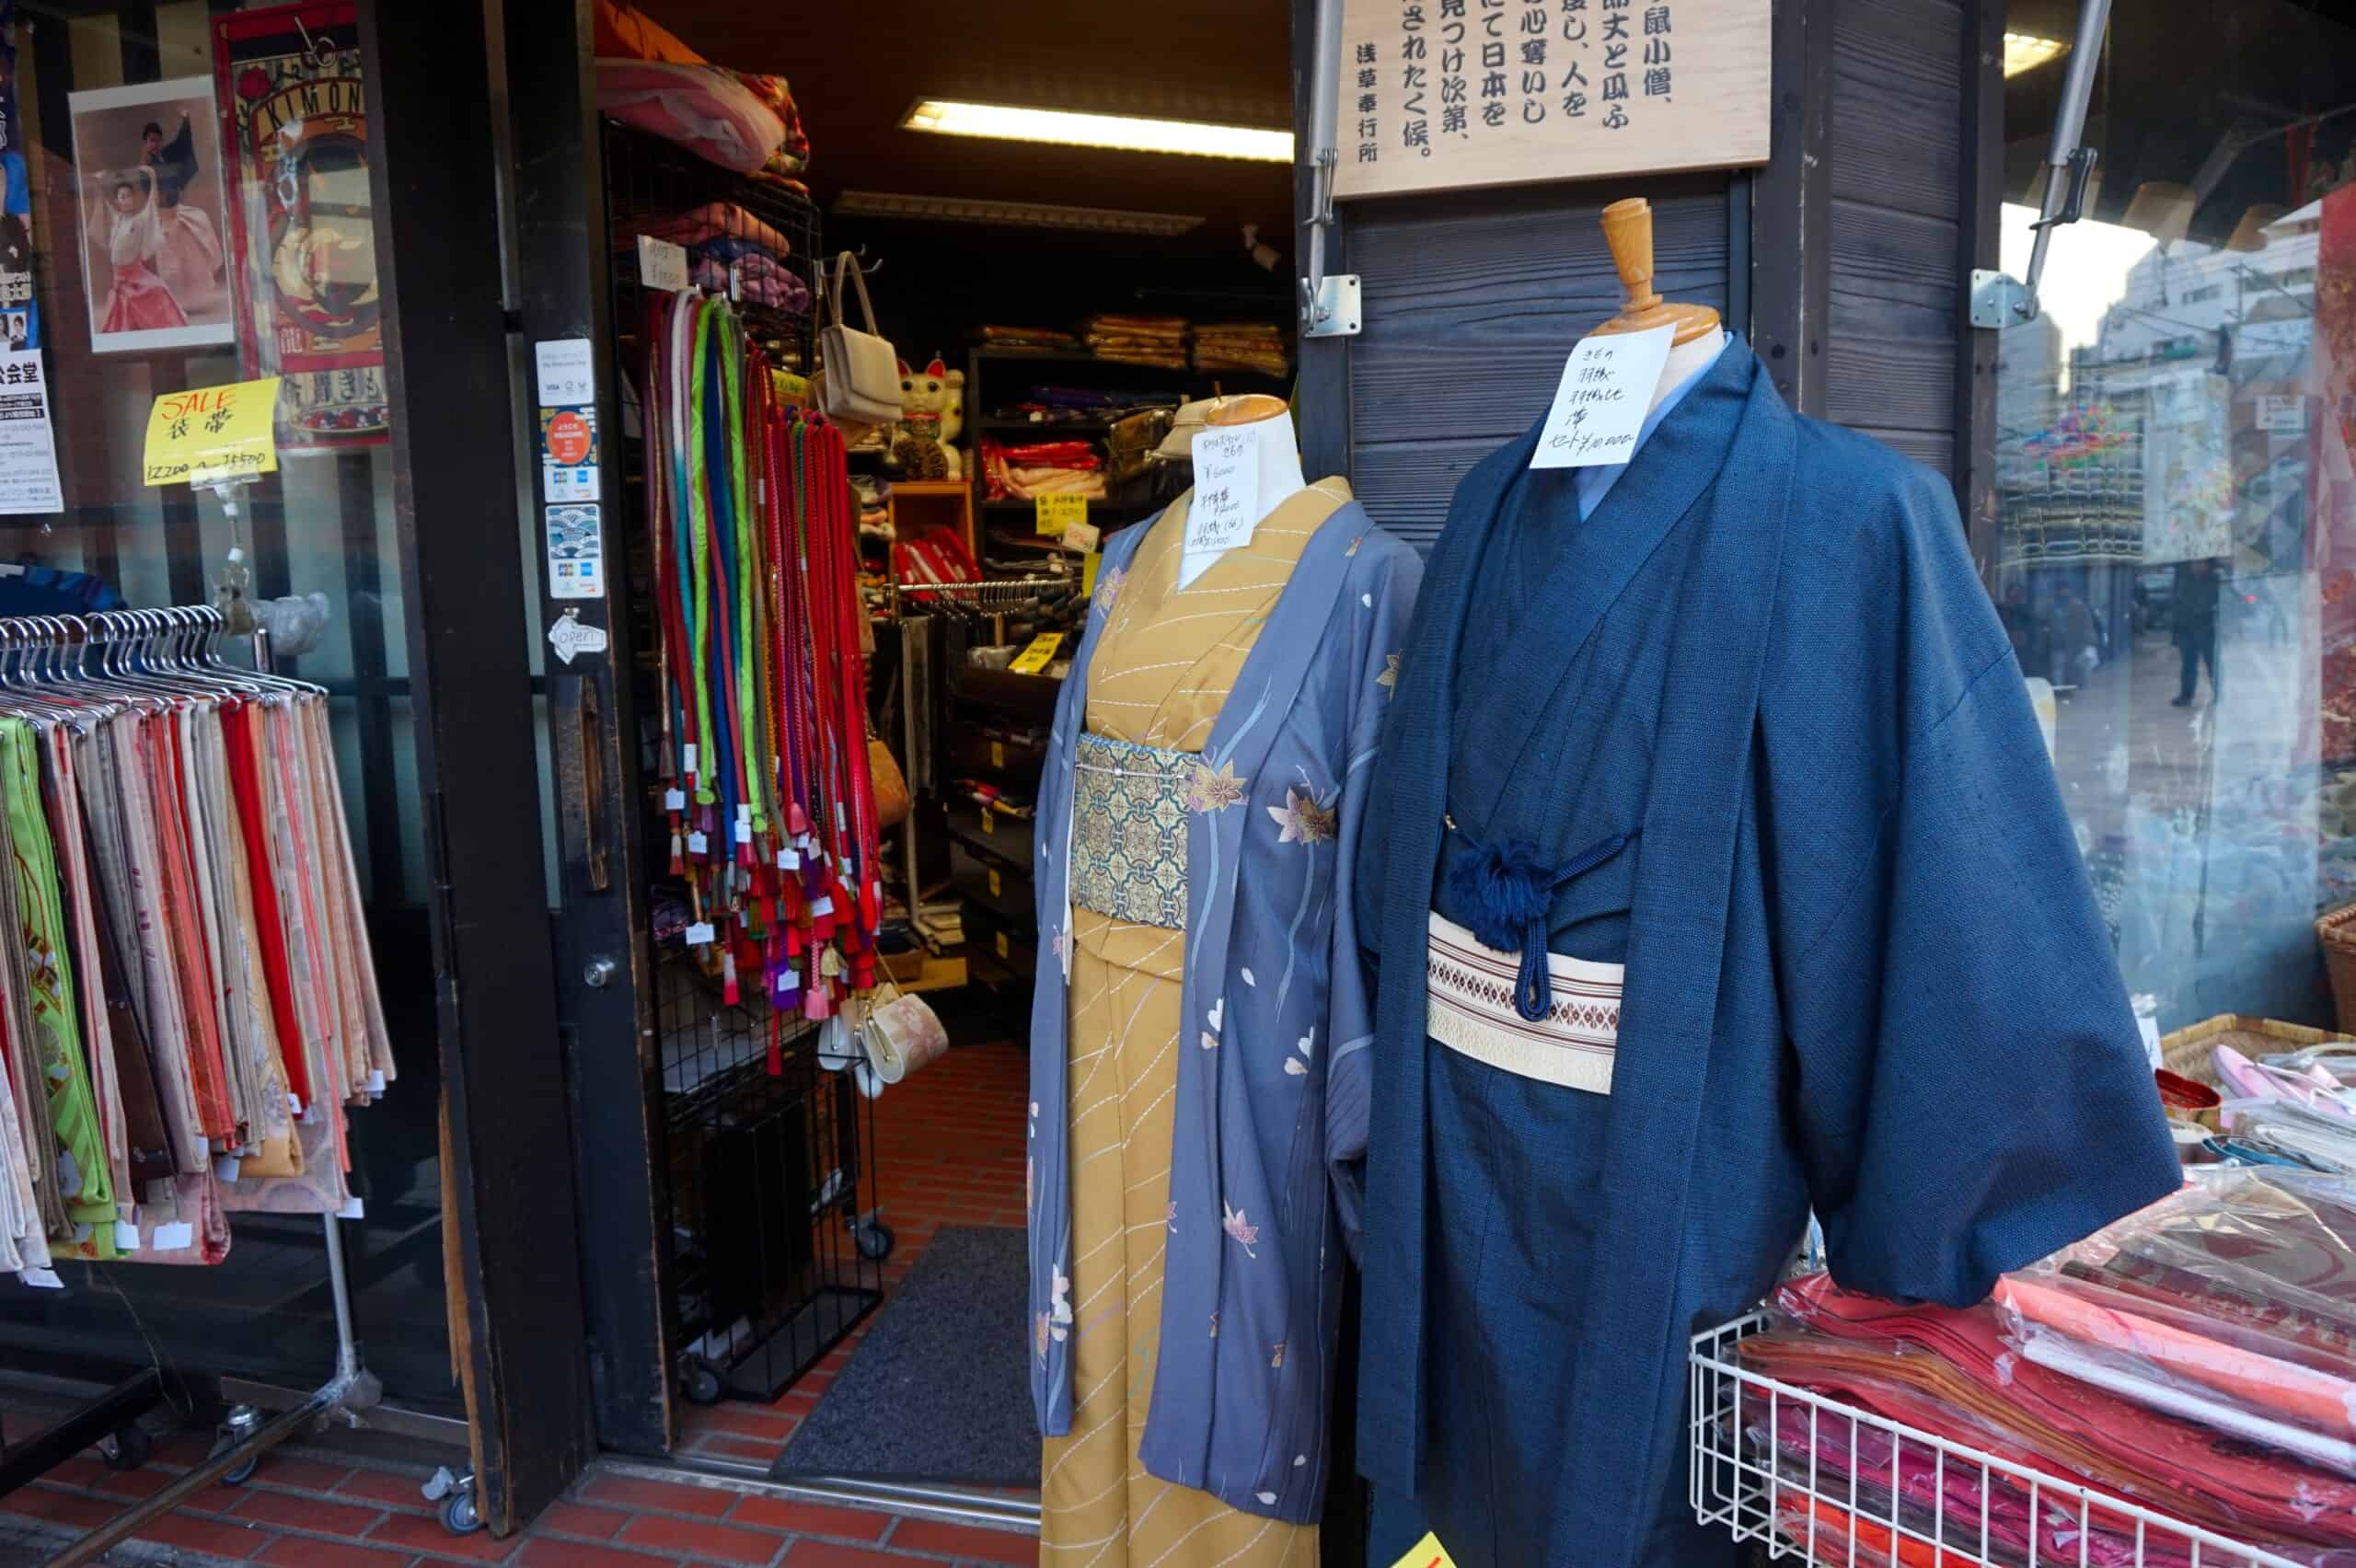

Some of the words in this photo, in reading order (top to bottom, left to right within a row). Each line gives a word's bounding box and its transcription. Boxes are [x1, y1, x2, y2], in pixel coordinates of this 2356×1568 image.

[266, 82, 362, 130] KIMON
[1357, 42, 1378, 163] 浅草奉行所
[1402, 0, 1431, 157] されたく候。
[1520, 0, 1548, 124] 心奪いし
[1643, 0, 1672, 103] 鼠小僧、
[161, 386, 237, 421] SALE
